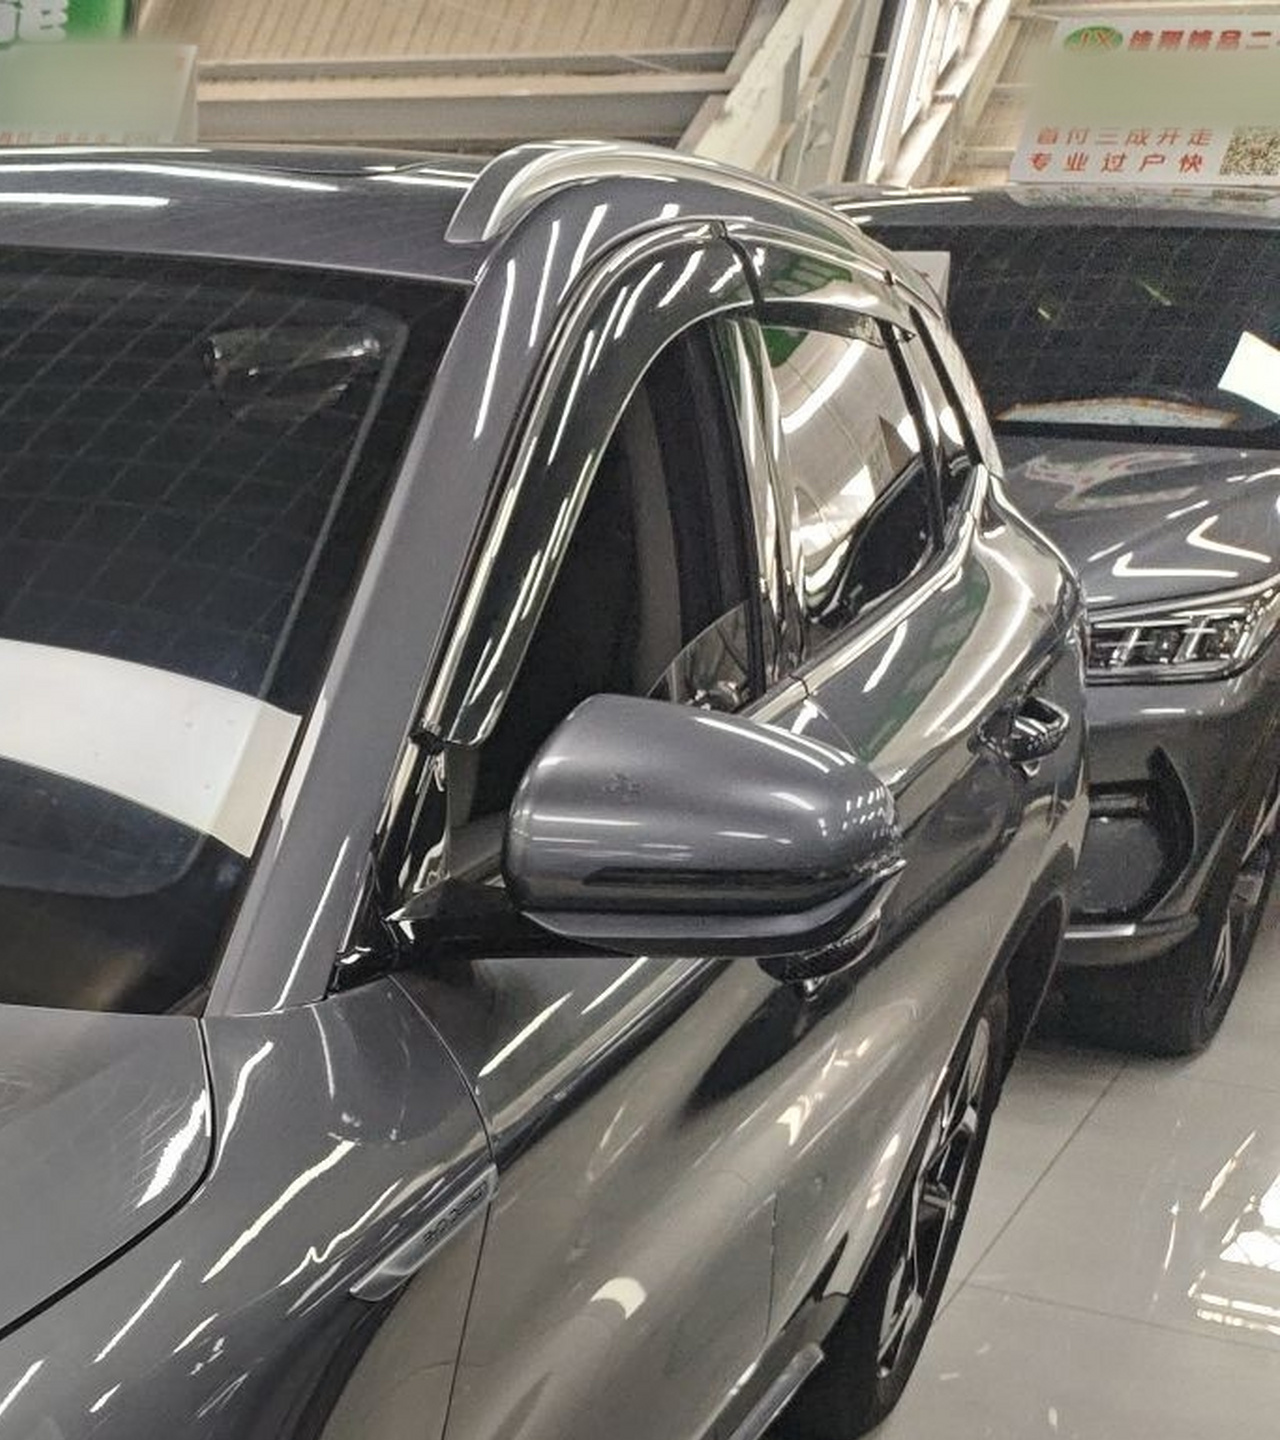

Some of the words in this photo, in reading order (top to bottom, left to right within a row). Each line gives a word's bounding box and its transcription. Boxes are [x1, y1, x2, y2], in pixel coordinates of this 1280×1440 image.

[1029, 152, 1203, 174] 专业过户快
